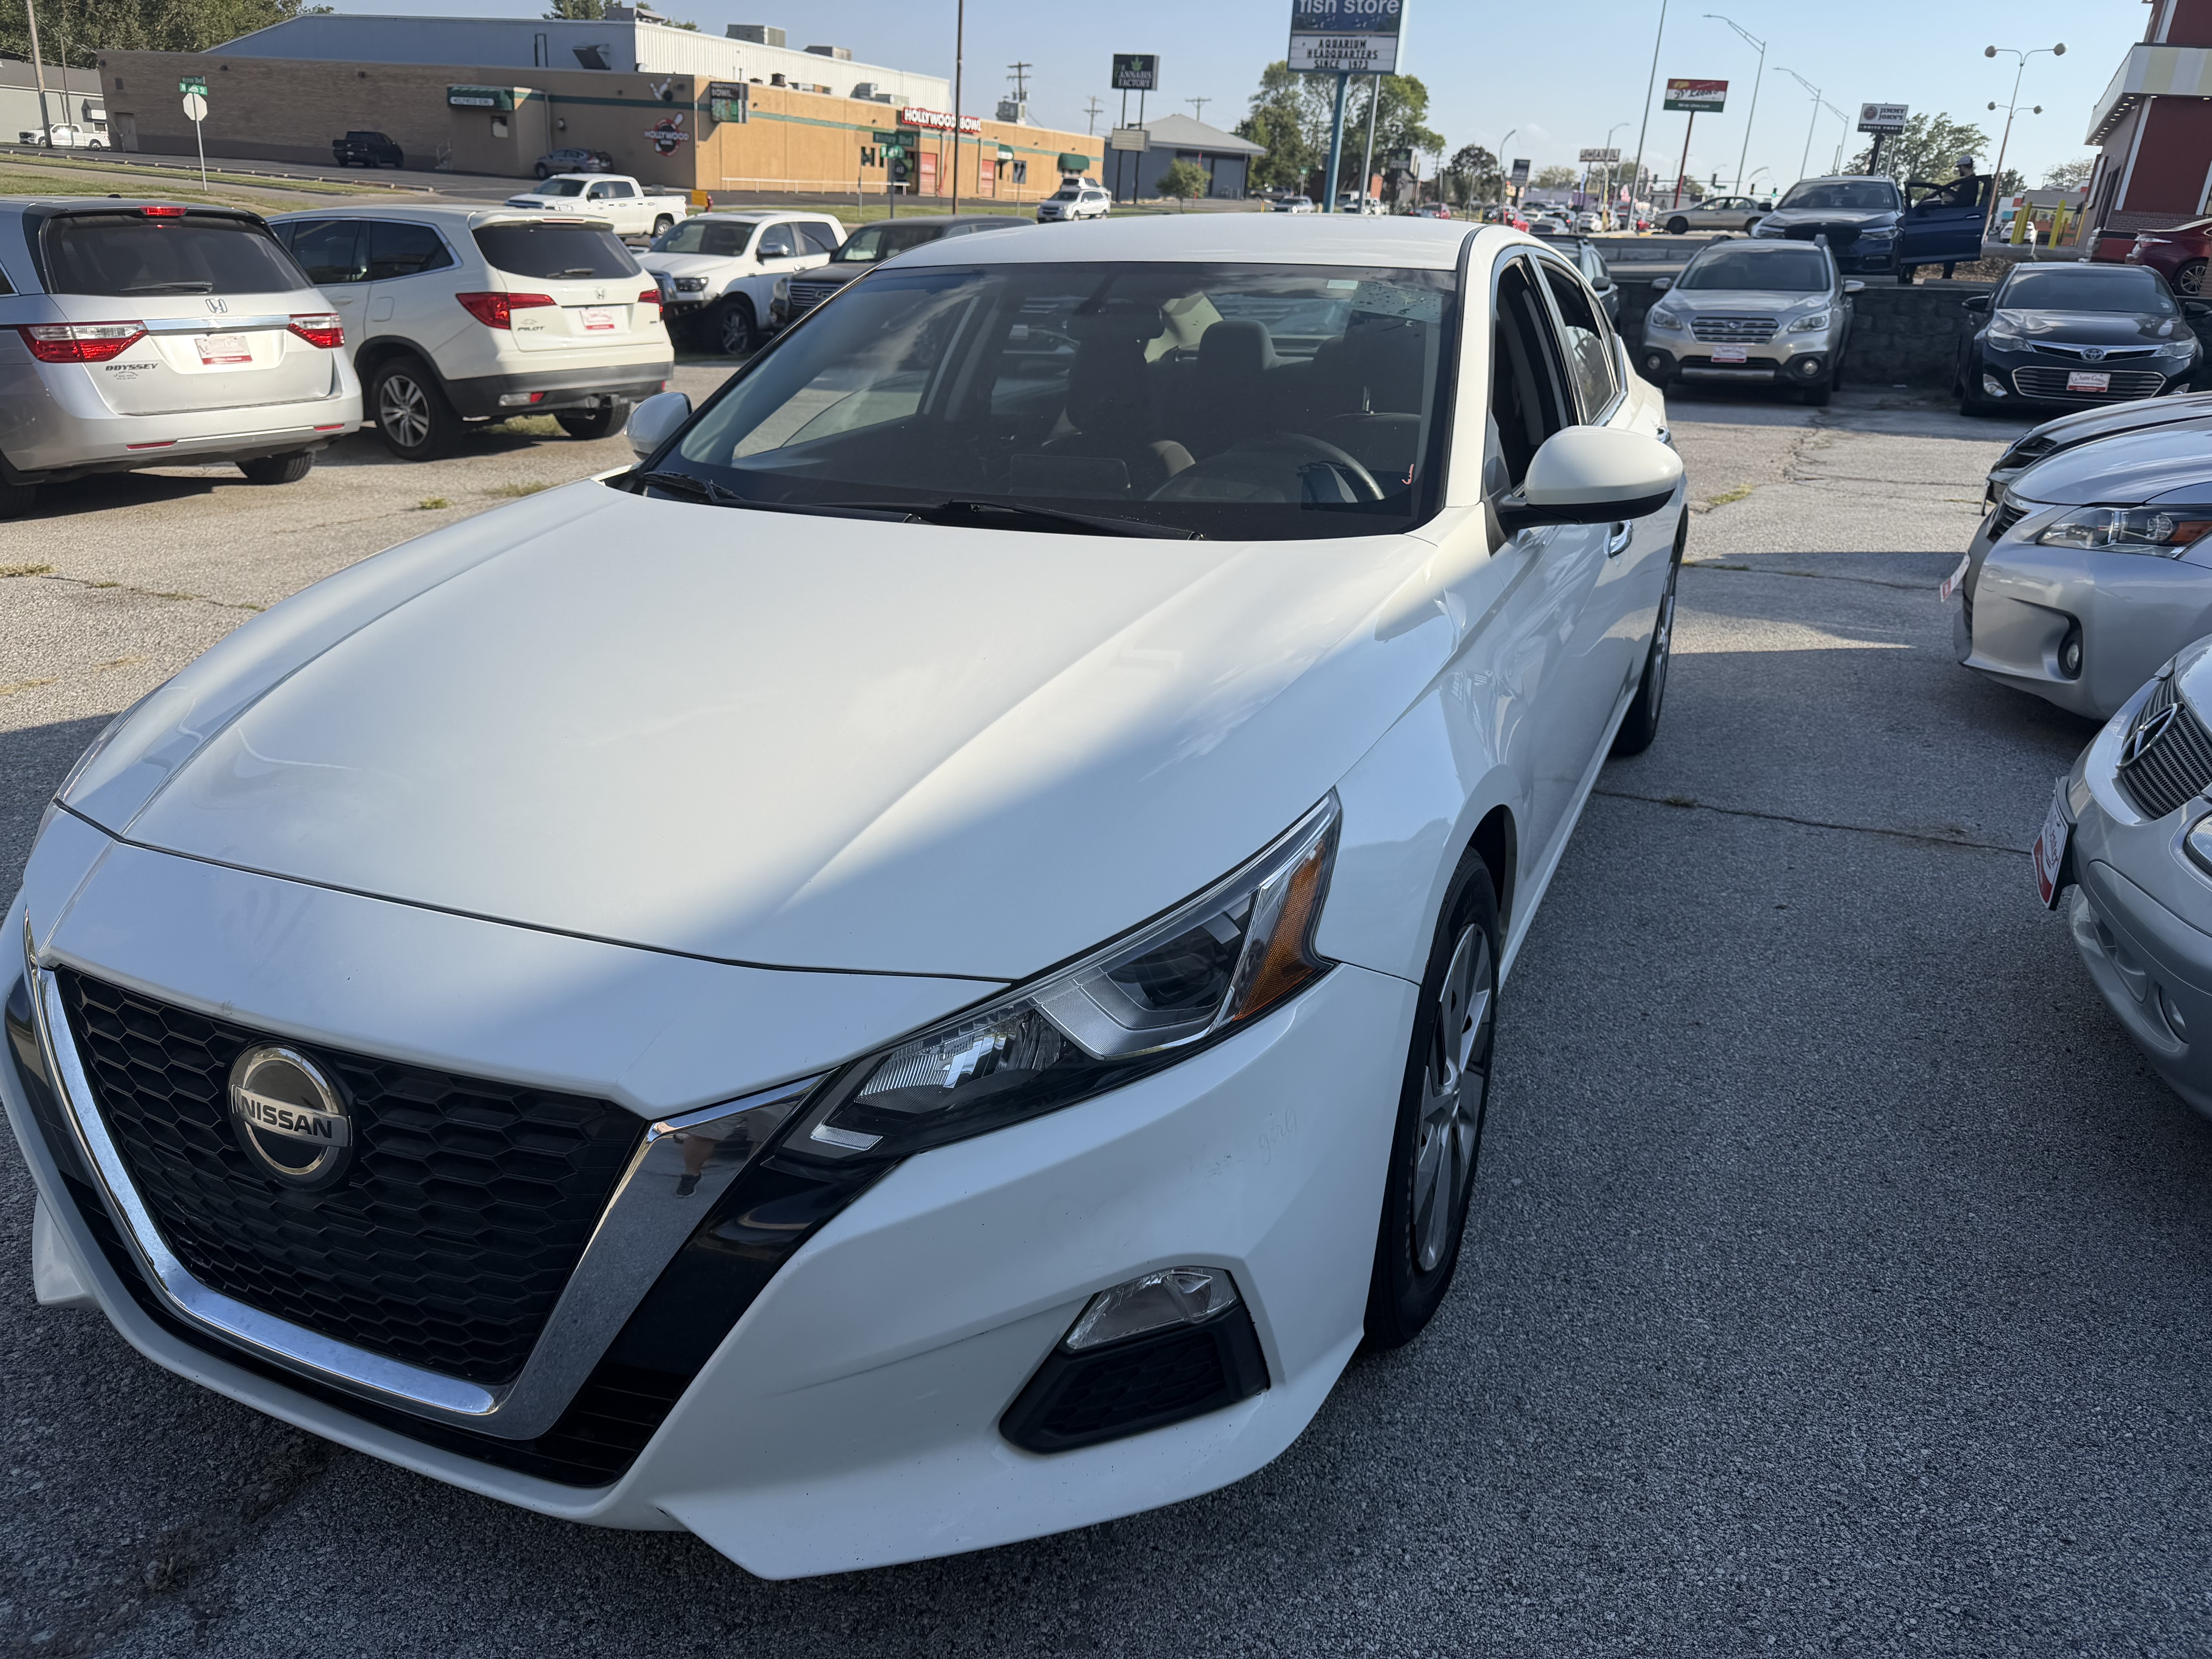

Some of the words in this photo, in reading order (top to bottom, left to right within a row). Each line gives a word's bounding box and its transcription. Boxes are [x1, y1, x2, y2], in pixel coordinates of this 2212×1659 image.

[1343, 0, 1400, 14] store
[1318, 40, 1367, 48] AQUARIUM
[1307, 49, 1379, 59] HEADQUARTERS
[1314, 60, 1340, 69] SINCE
[1348, 60, 1368, 69] 1973
[904, 108, 957, 128] HOLLYWOOD
[959, 117, 982, 132] BOWL
[644, 131, 689, 141] HOLLYWOOD
[240, 1095, 333, 1139] NISSAN
